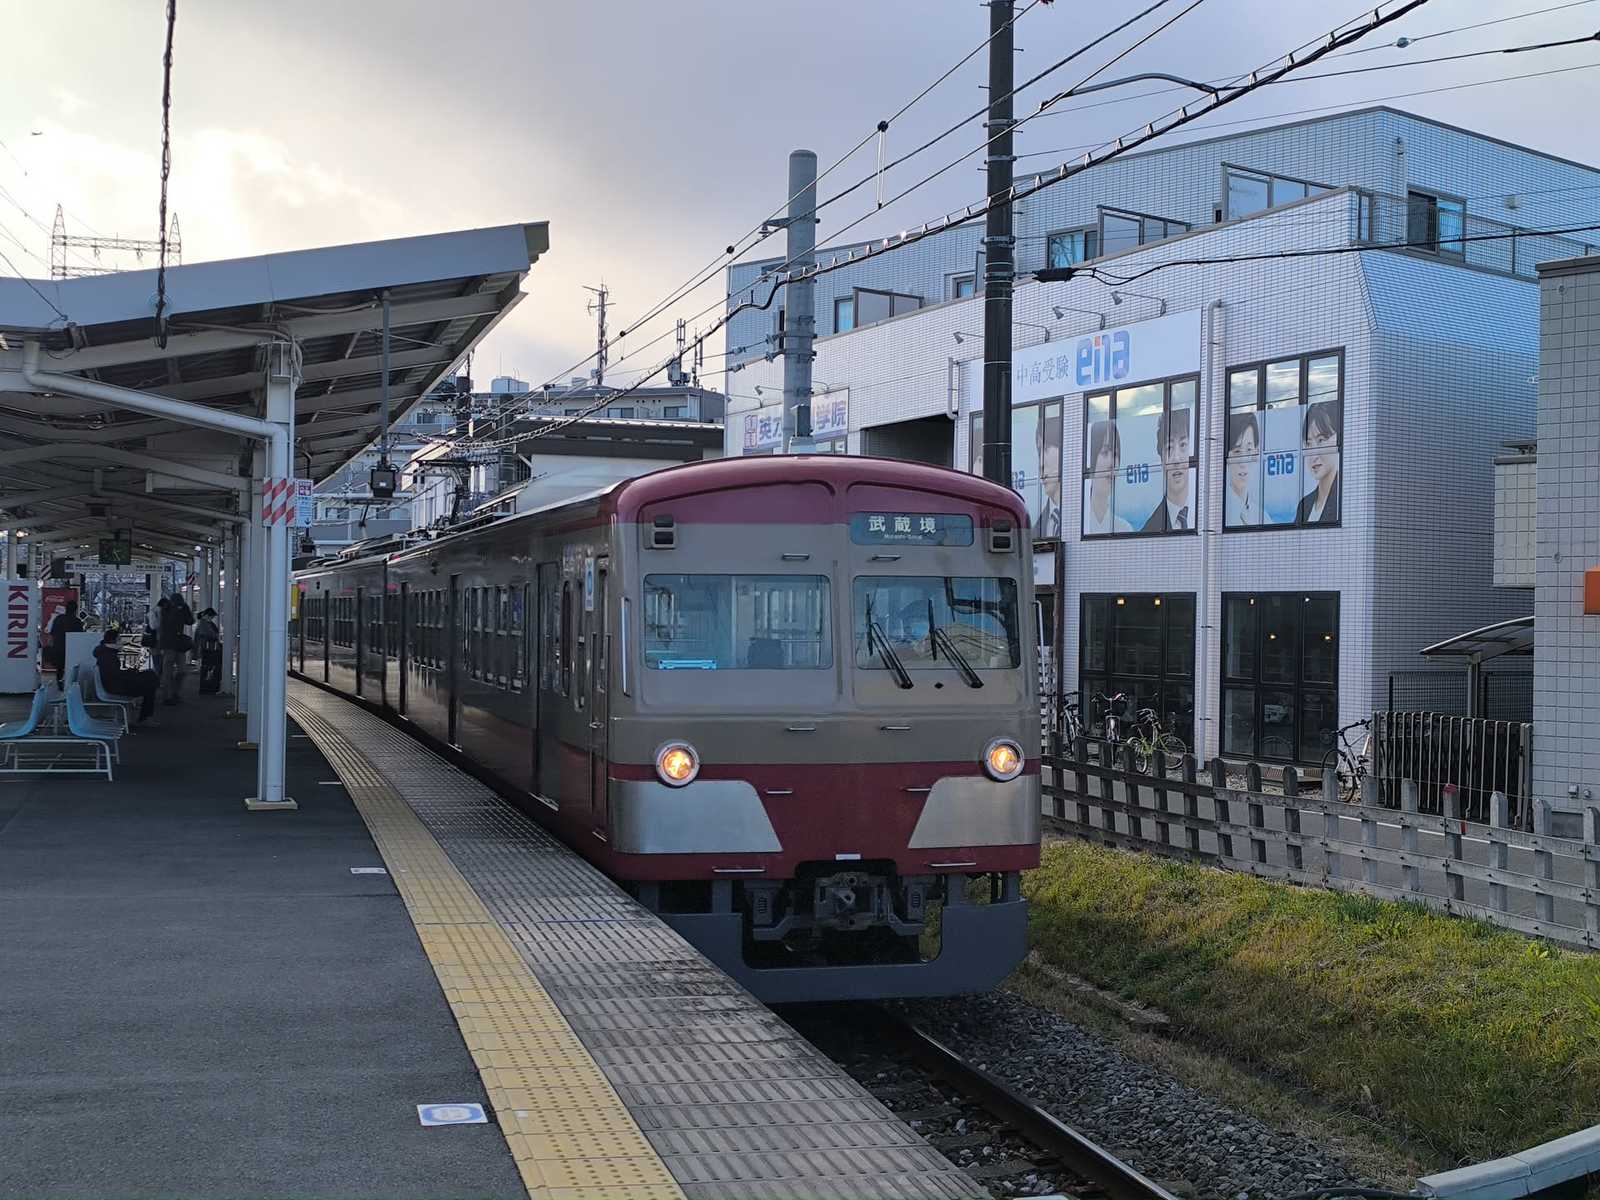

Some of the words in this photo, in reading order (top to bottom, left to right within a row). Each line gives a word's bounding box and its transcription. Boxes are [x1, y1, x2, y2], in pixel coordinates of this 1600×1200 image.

[1017, 355, 1070, 387] 中高受験
[1076, 330, 1130, 386] ena
[1126, 463, 1149, 484] ena
[1267, 453, 1295, 476] ena
[868, 515, 937, 533] 武蔵境
[8, 585, 28, 659] KIRIN
